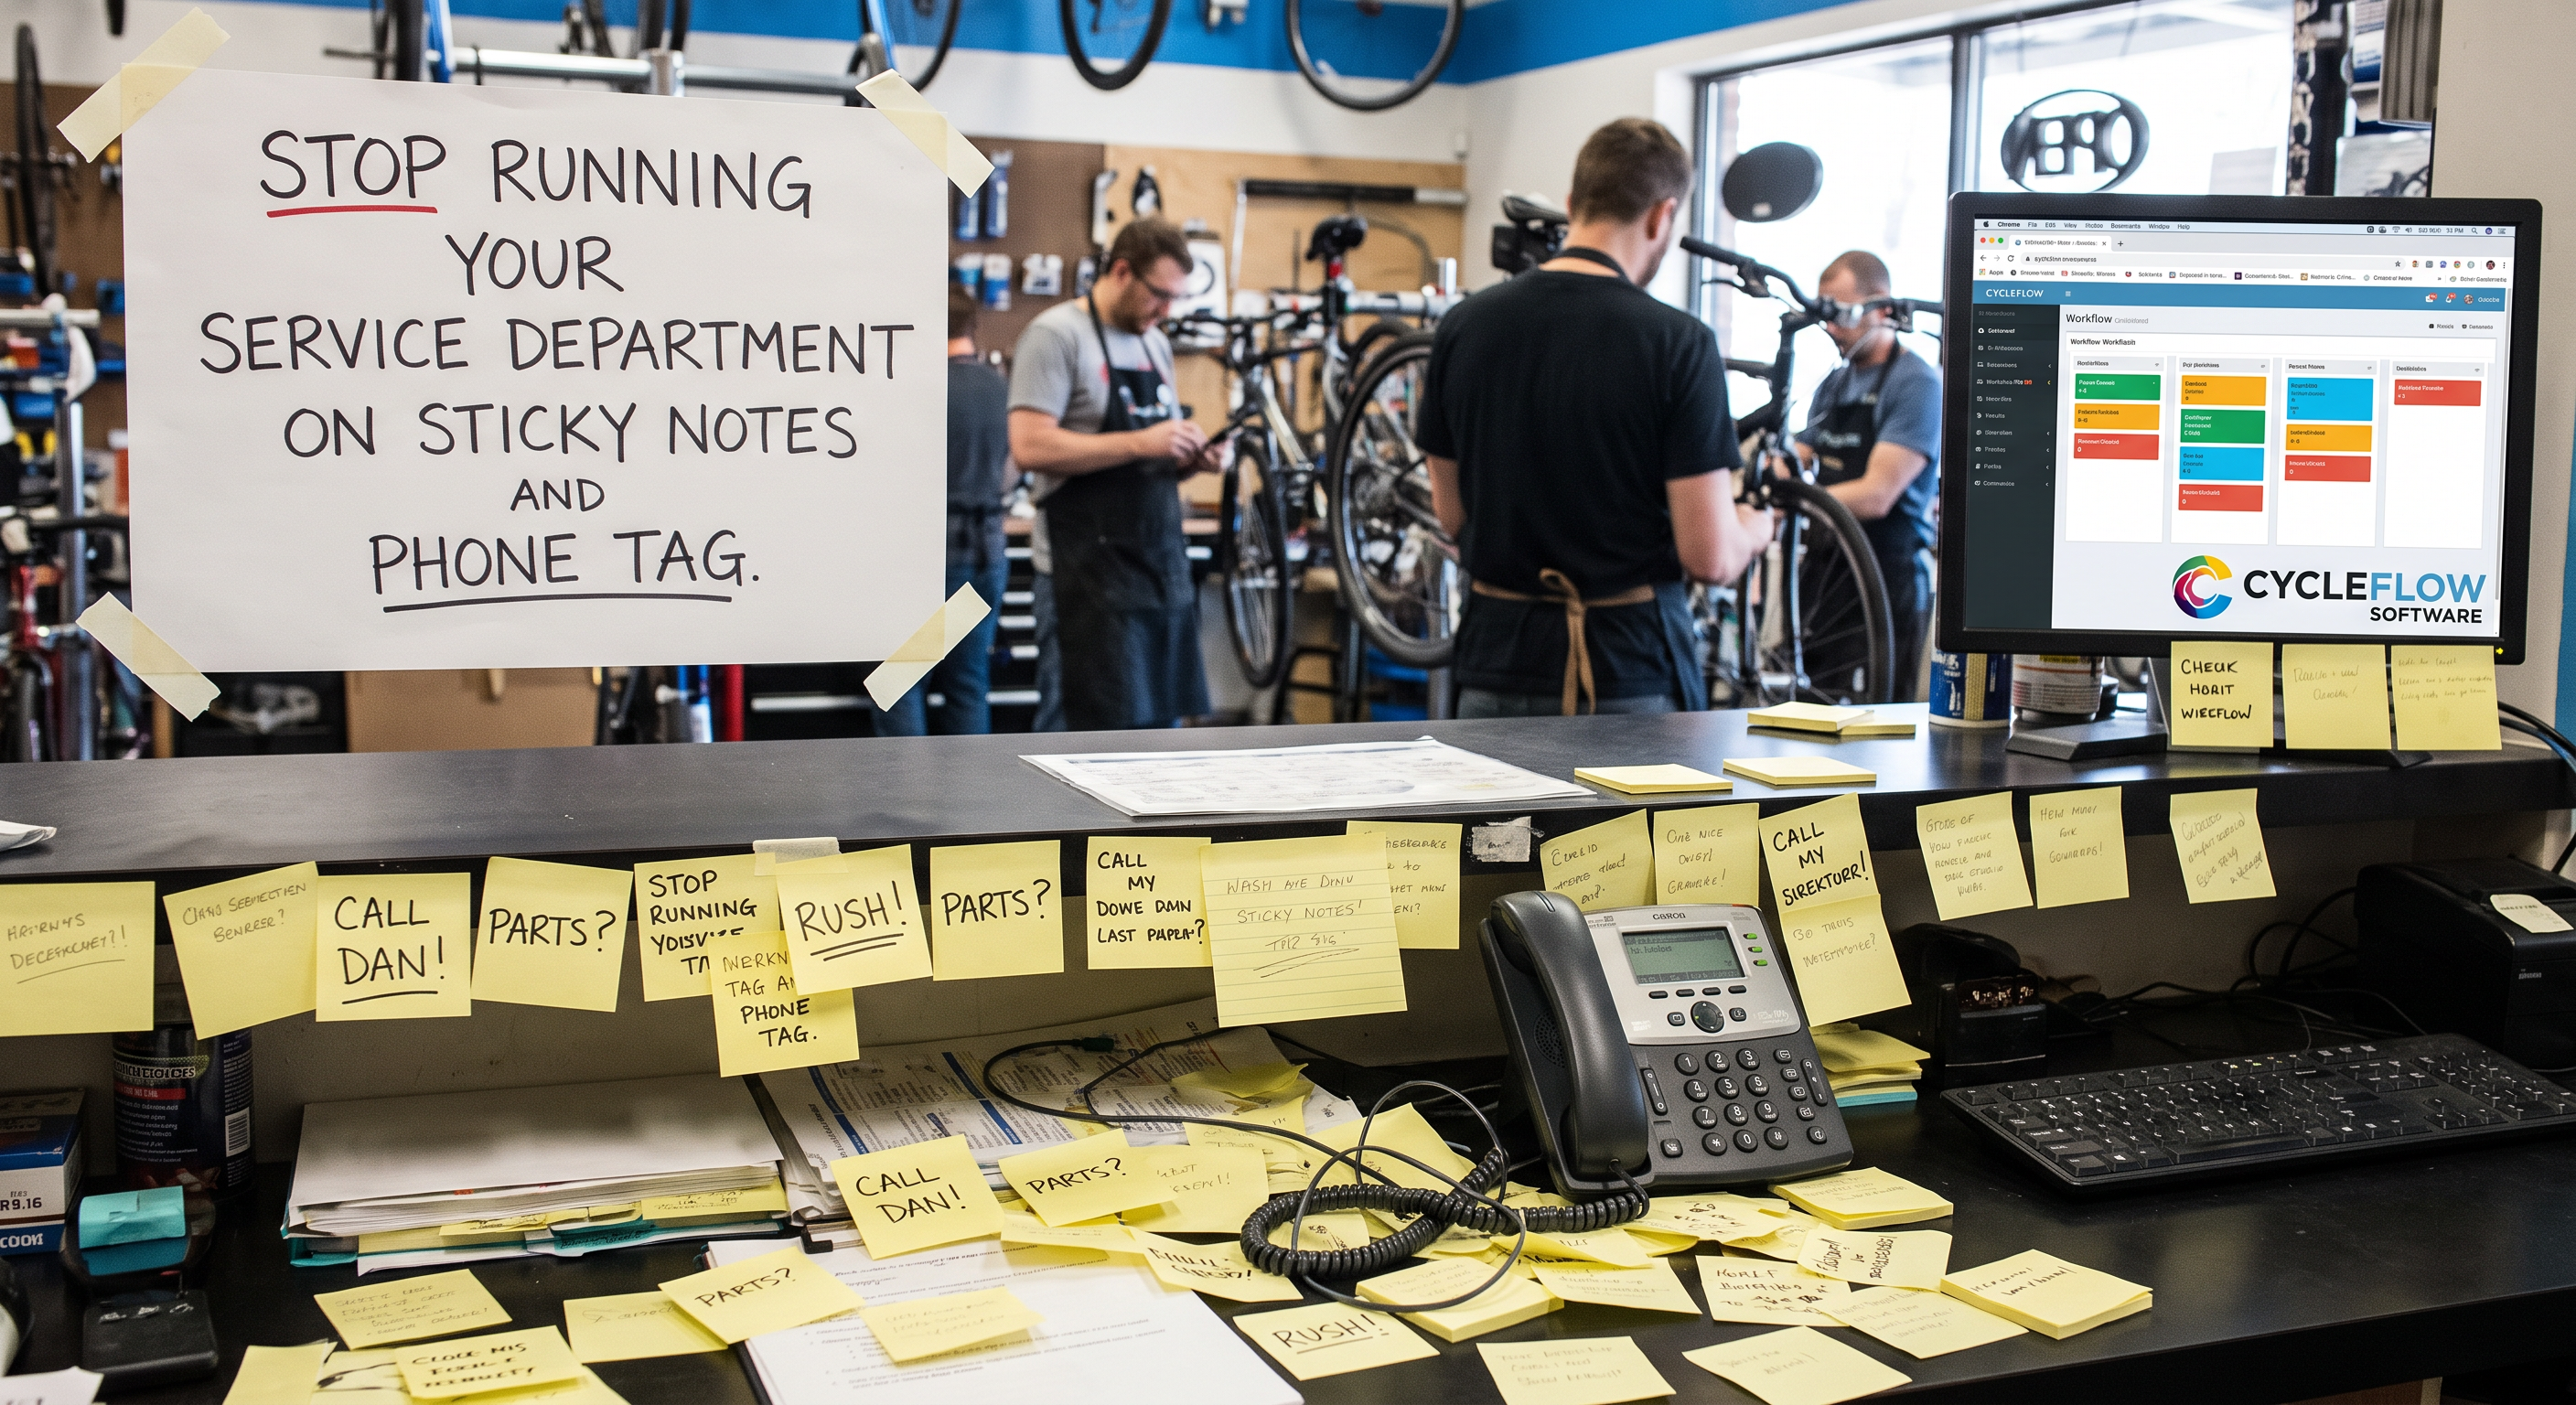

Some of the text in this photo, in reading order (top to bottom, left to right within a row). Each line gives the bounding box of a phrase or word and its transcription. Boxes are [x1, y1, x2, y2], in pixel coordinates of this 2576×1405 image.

[260, 129, 811, 220] STOP RUNNING
[444, 231, 625, 296] YOUR
[1986, 289, 2044, 297] CYCLEFLOW
[2066, 314, 2113, 324] Workflow
[199, 311, 915, 380] SERVICE DEPARTMENT
[284, 402, 857, 464] ON STICKY NOTES
[510, 477, 606, 512] AND
[369, 529, 759, 595] PHONE TAG.
[2244, 570, 2486, 603] CYCLEFLOW
[2370, 606, 2483, 623] SOFTWARE
[1772, 821, 1825, 856] CALL
[1097, 851, 1147, 870] CALL
[1798, 845, 1825, 870] MY
[648, 869, 718, 898] STOP
[1128, 874, 1155, 893] MY
[1227, 877, 1272, 895] WASH
[334, 896, 430, 931] CALL
[649, 897, 757, 926] RUNNING
[795, 881, 907, 941] RUSH!
[940, 878, 1051, 927] PARTS?
[1096, 900, 1143, 917] DOWE
[1237, 908, 1293, 924] STICKY
[488, 907, 617, 952] PARTS?
[1097, 928, 1137, 944] LAST
[337, 935, 445, 985] DAN!
[724, 978, 766, 998] TAG
[740, 997, 810, 1024] PHONE
[757, 1024, 818, 1047] TAG.
[1685, 1057, 1692, 1067] 1
[1714, 1053, 1723, 1063] 2
[1693, 1076, 1763, 1092] 4 5 6
[1701, 1103, 1772, 1119] 7 8 9
[1743, 1133, 1752, 1144] 0
[855, 1167, 940, 1196] CALL
[1025, 1157, 1127, 1195] PARTS?
[871, 1179, 966, 1224] DAN!
[695, 1266, 797, 1307] PARTS?
[1272, 1314, 1389, 1349] RUSH!
